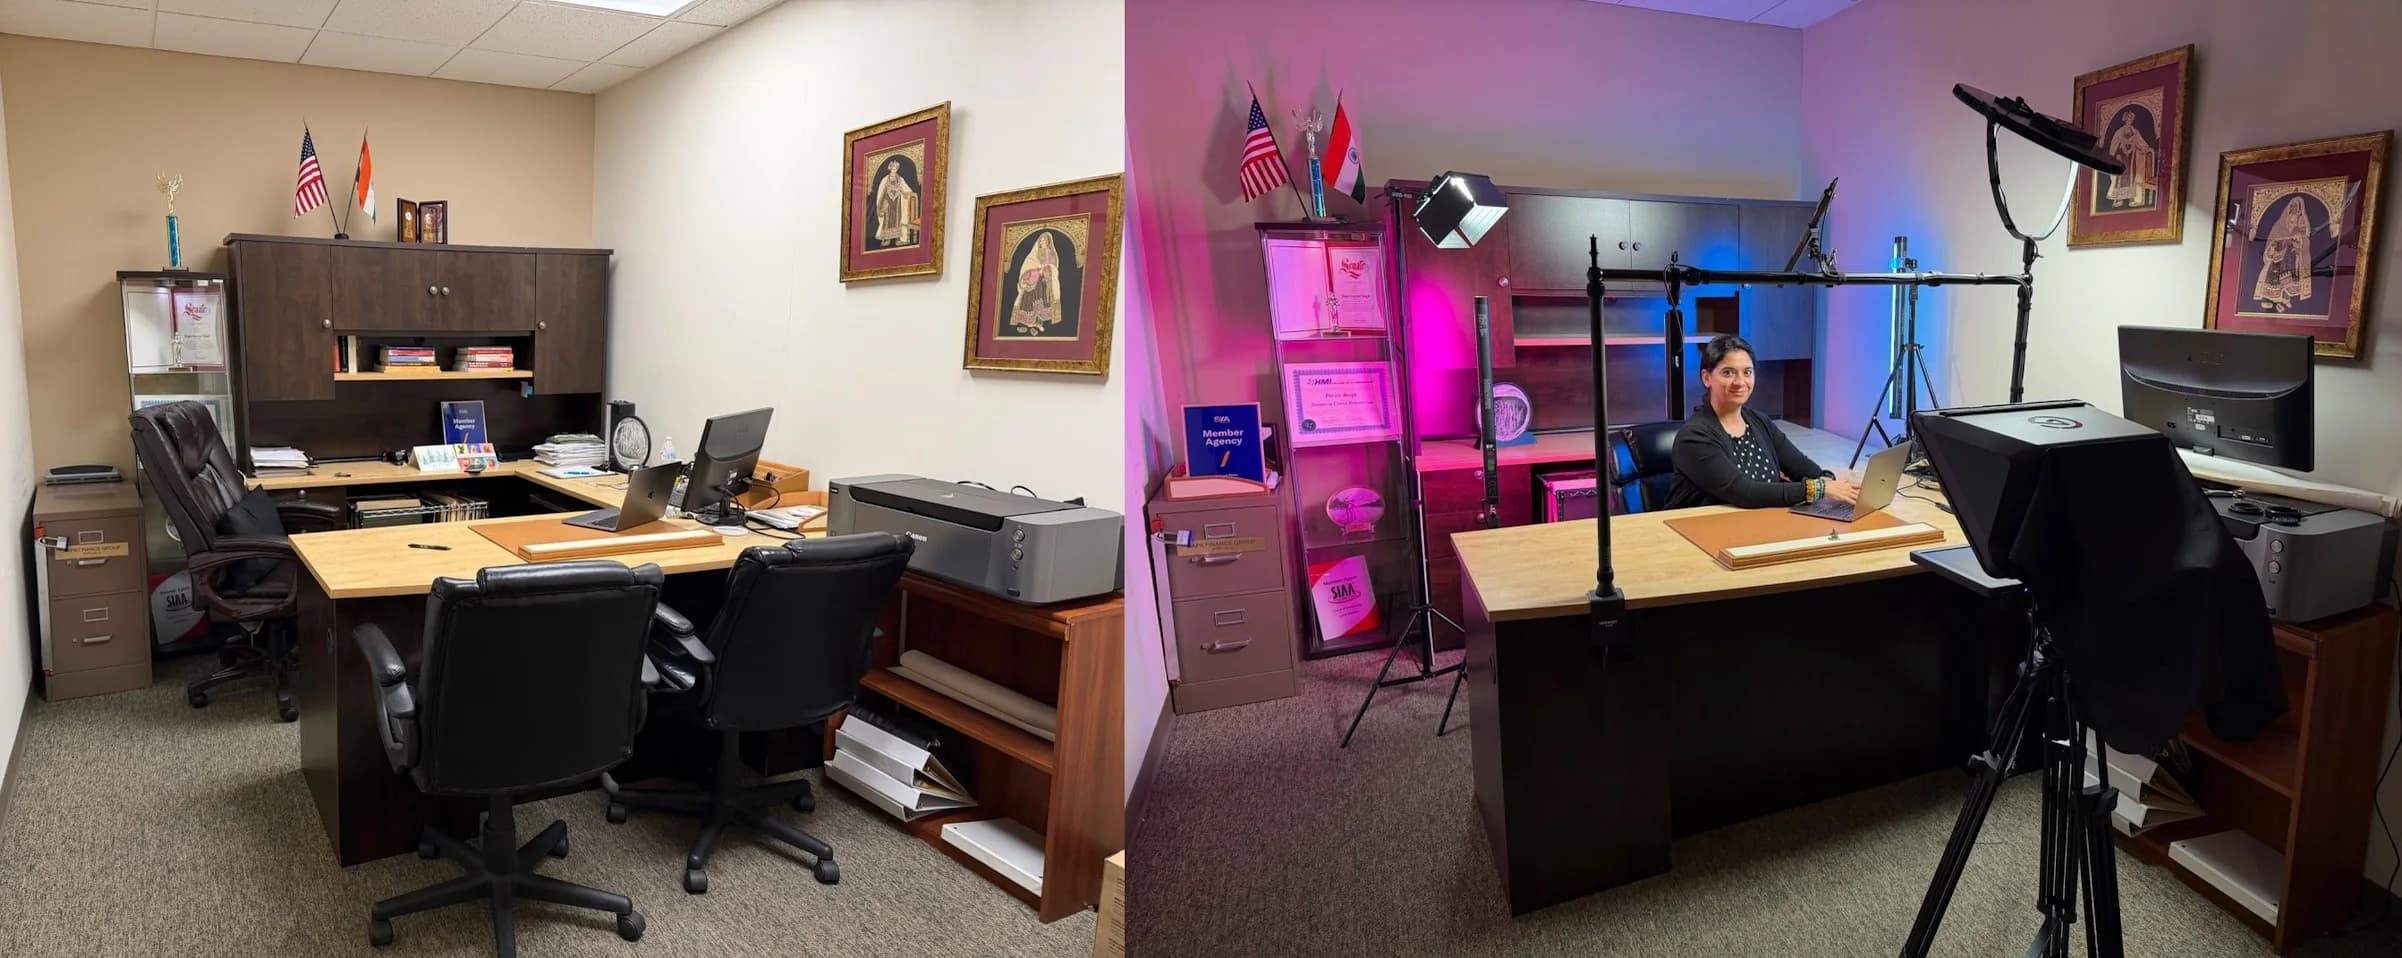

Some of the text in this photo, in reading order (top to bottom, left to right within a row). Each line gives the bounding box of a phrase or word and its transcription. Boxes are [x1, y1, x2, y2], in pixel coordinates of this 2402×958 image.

[1202, 428, 1244, 438] Member
[1205, 438, 1243, 448] Agency
[1331, 582, 1356, 600] SIAA
[166, 592, 188, 608] SIAA
